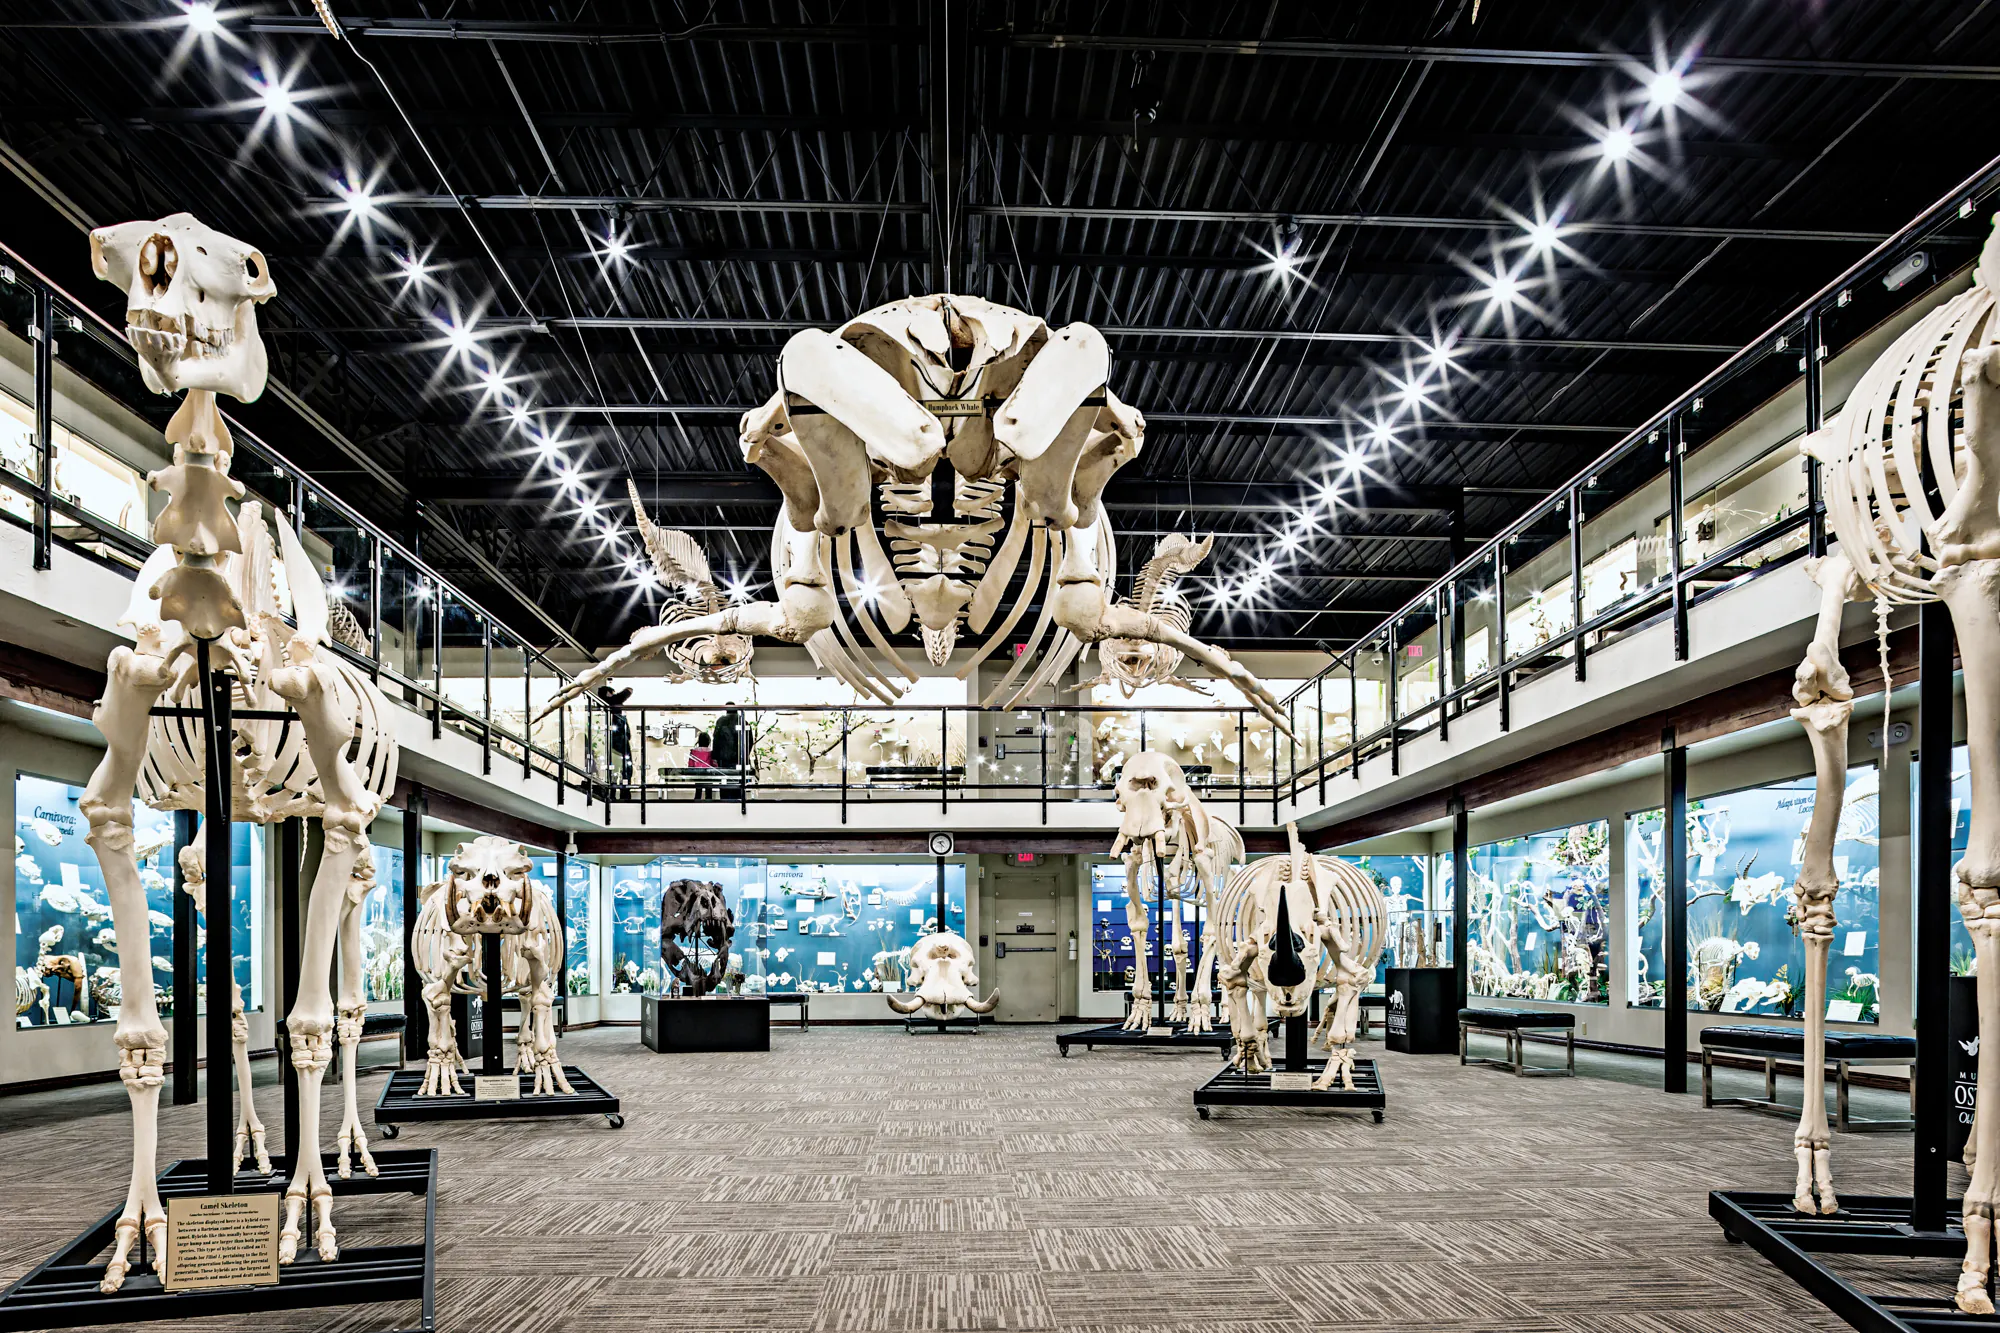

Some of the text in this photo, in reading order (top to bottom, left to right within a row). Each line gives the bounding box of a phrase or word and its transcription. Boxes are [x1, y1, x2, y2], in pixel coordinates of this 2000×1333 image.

[928, 404, 959, 412] Humpback
[34, 805, 76, 825] Carnivora:
[768, 870, 804, 878] Carnivora
